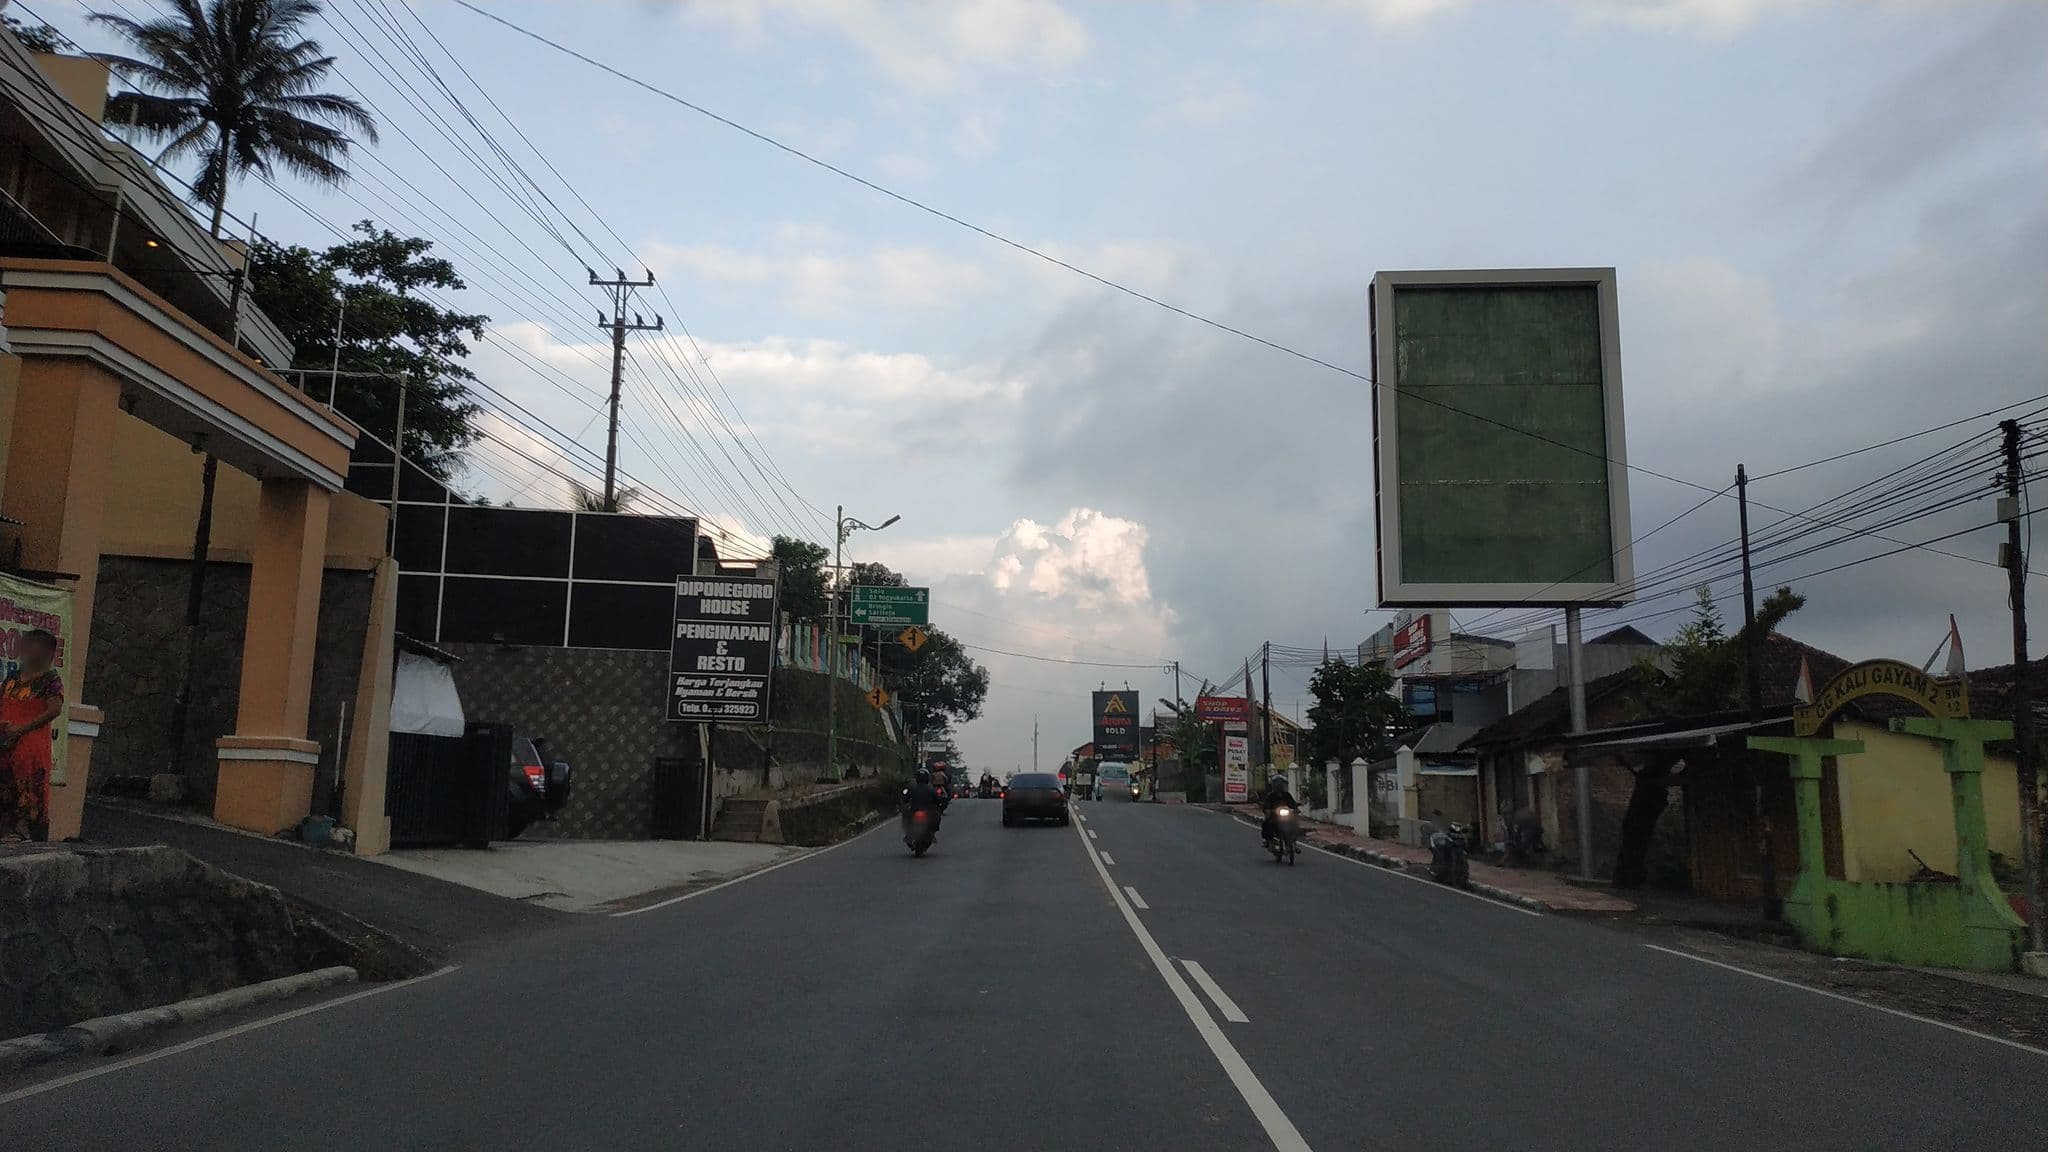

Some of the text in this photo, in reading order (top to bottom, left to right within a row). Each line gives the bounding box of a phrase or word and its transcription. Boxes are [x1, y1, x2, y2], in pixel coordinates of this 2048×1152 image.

[678, 581, 773, 599] DIPONEGORO
[700, 598, 750, 615] HOUSE
[677, 624, 770, 641] PENGINAPAN
[716, 640, 728, 655] &
[697, 655, 745, 672] RESTO
[676, 676, 764, 689] Harga Terjangkau
[1835, 671, 1866, 700] KALI
[1872, 667, 1927, 696] GAYAM
[1930, 686, 1938, 704] 2
[675, 687, 758, 698] Nyaman & Bersih
